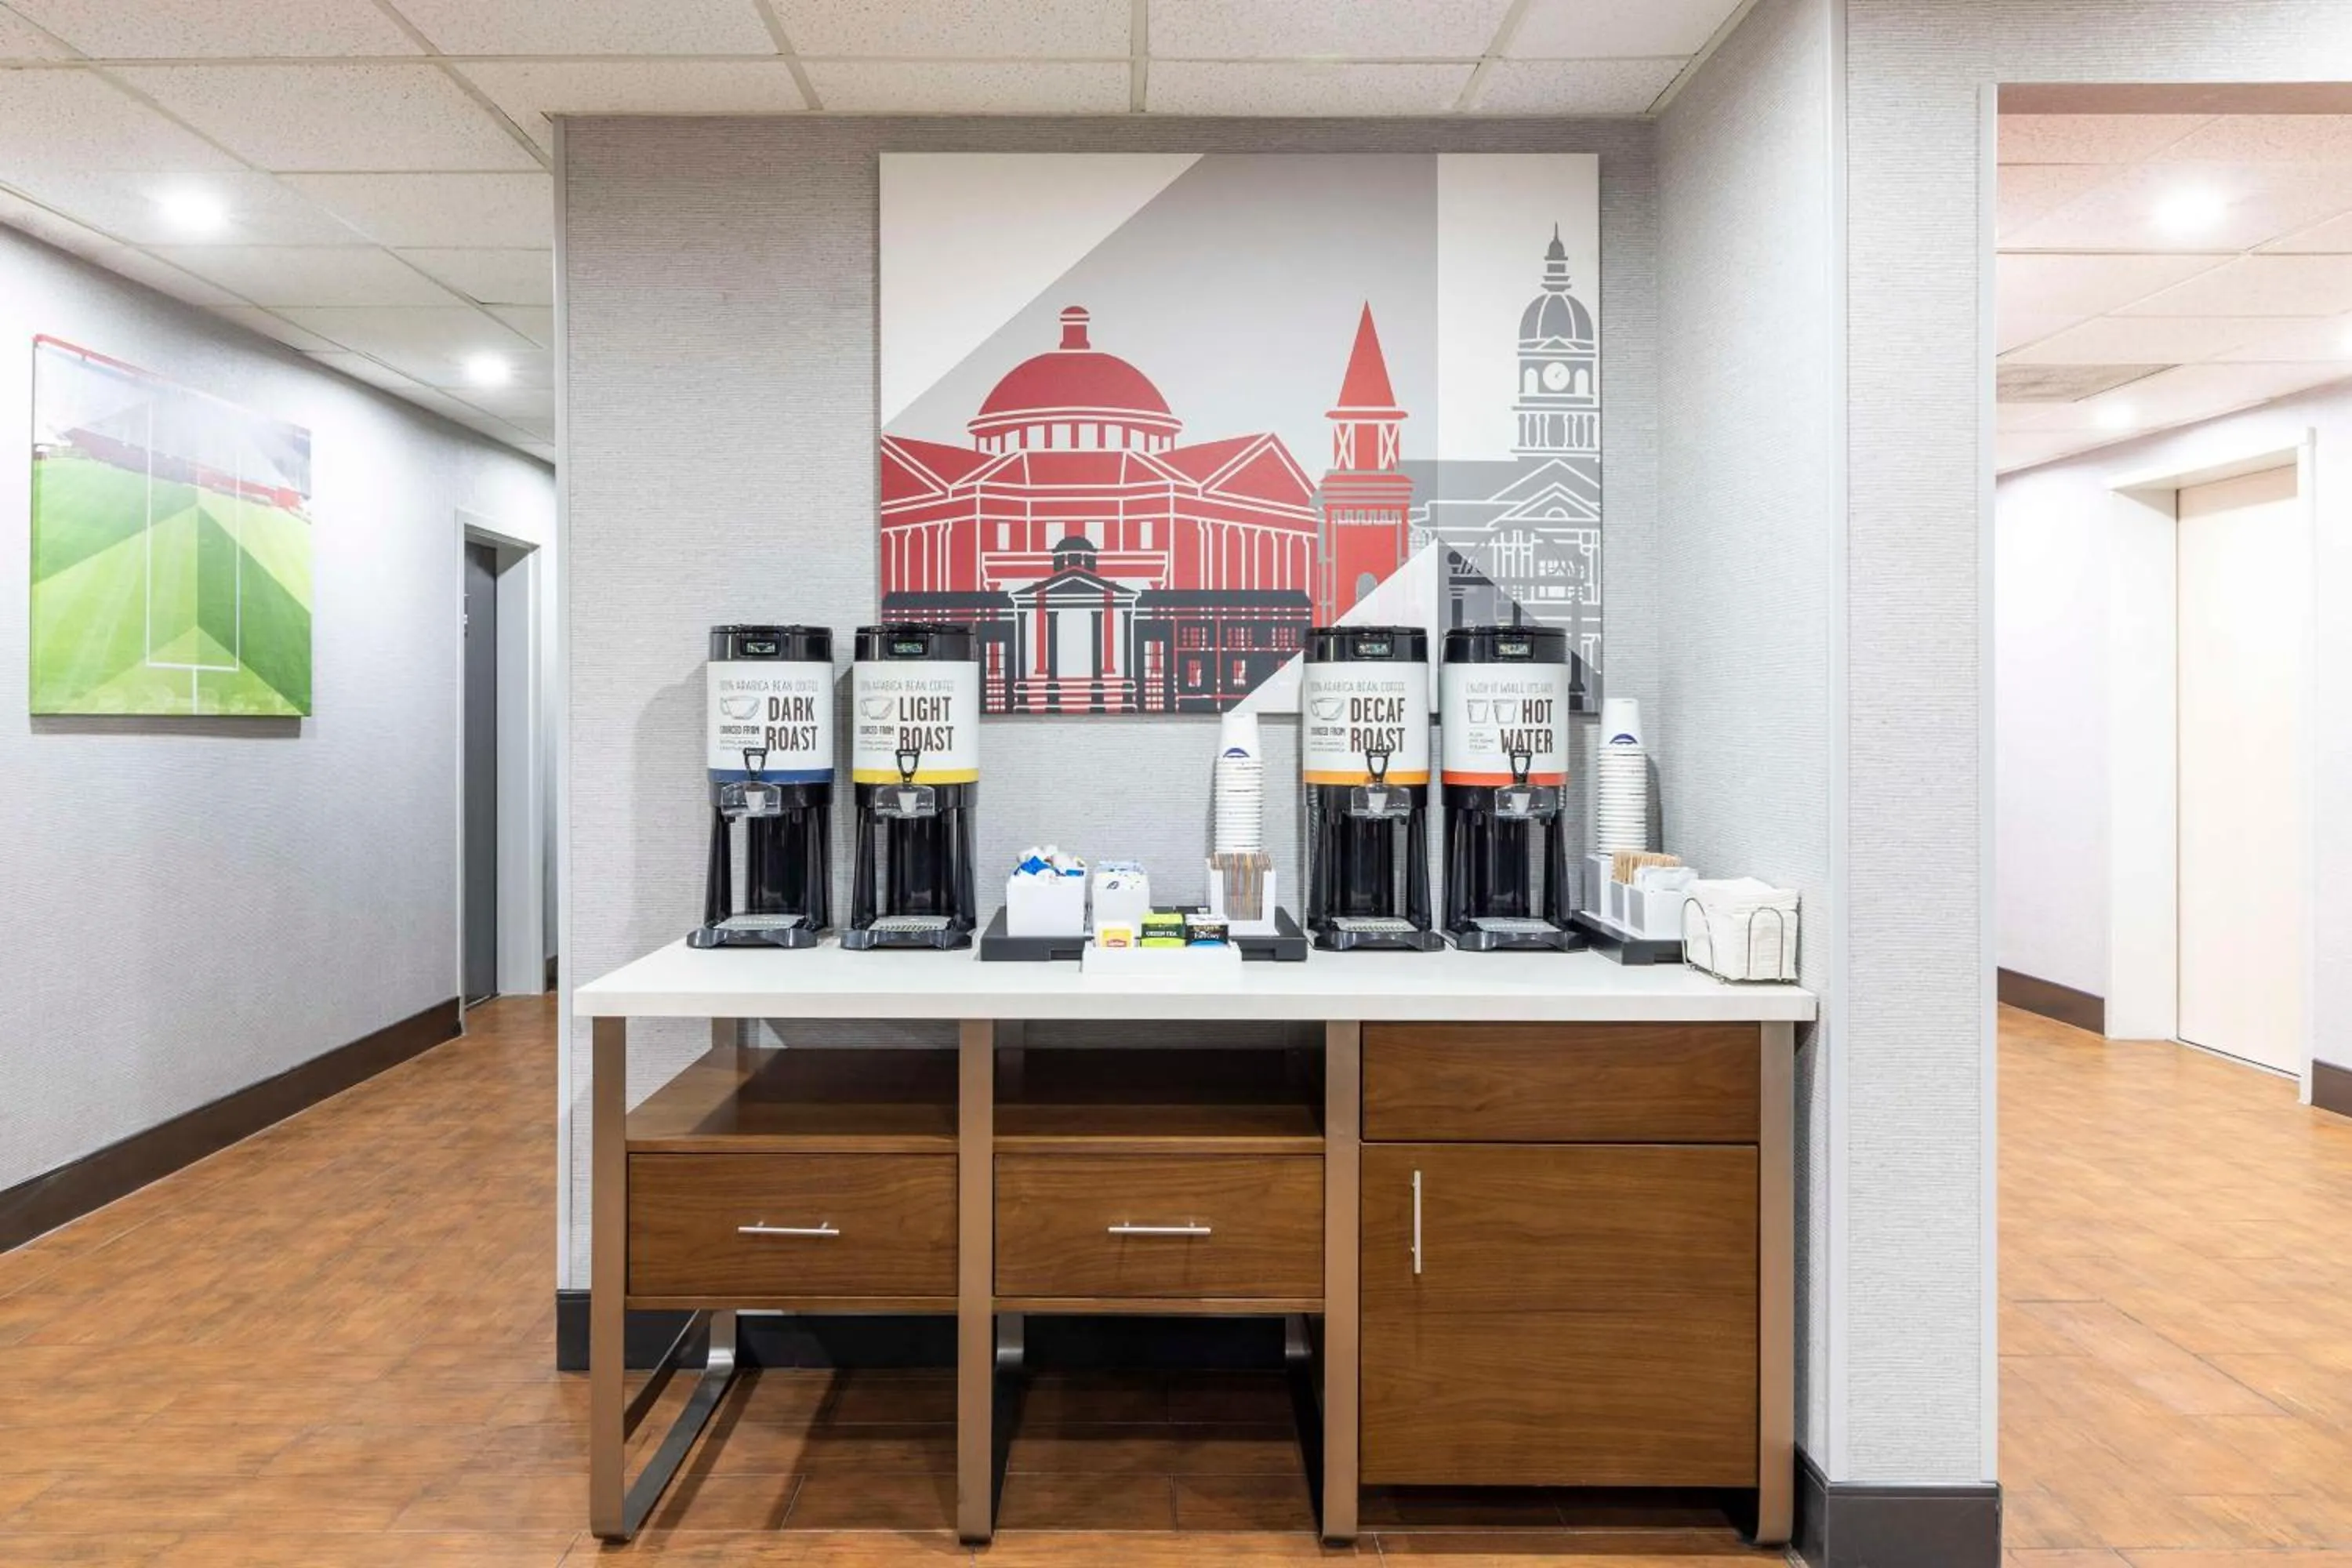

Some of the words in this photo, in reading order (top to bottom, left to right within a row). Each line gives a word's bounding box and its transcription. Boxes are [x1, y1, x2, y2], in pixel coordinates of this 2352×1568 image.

[768, 696, 815, 721] DARK
[899, 696, 952, 721] LIGHT
[1351, 697, 1406, 723] DECAF
[1522, 699, 1553, 724] HOT
[765, 725, 818, 751] ROAST
[899, 725, 954, 751] ROAST
[1351, 727, 1406, 753] ROAST
[1500, 728, 1553, 753] WATER
